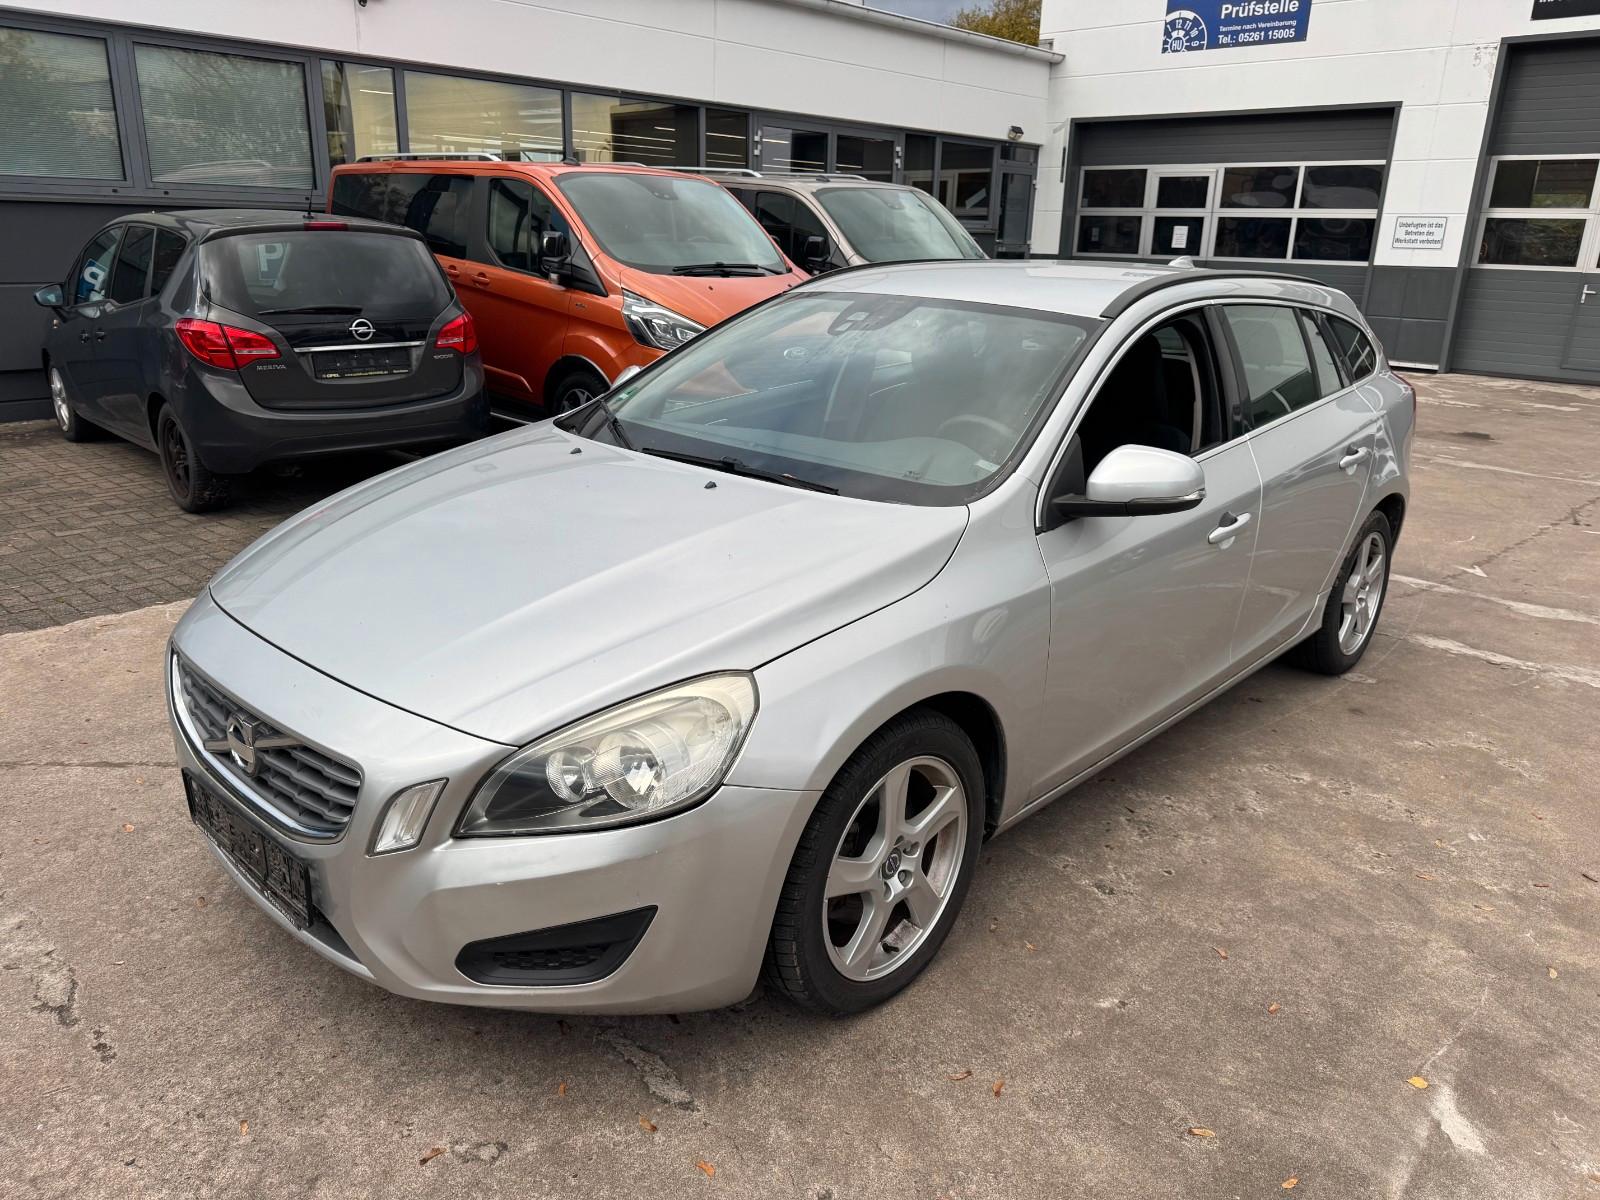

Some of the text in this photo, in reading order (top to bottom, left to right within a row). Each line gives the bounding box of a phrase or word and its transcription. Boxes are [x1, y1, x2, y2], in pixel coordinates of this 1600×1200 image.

[1220, 0, 1299, 19] Prüfstelle
[1175, 19, 1183, 29] 12
[1219, 19, 1297, 32] Termine nach Vereinbarung
[1189, 27, 1199, 38] 10
[1218, 28, 1295, 45] Tel.: 05261 15005
[1171, 40, 1182, 50] HU
